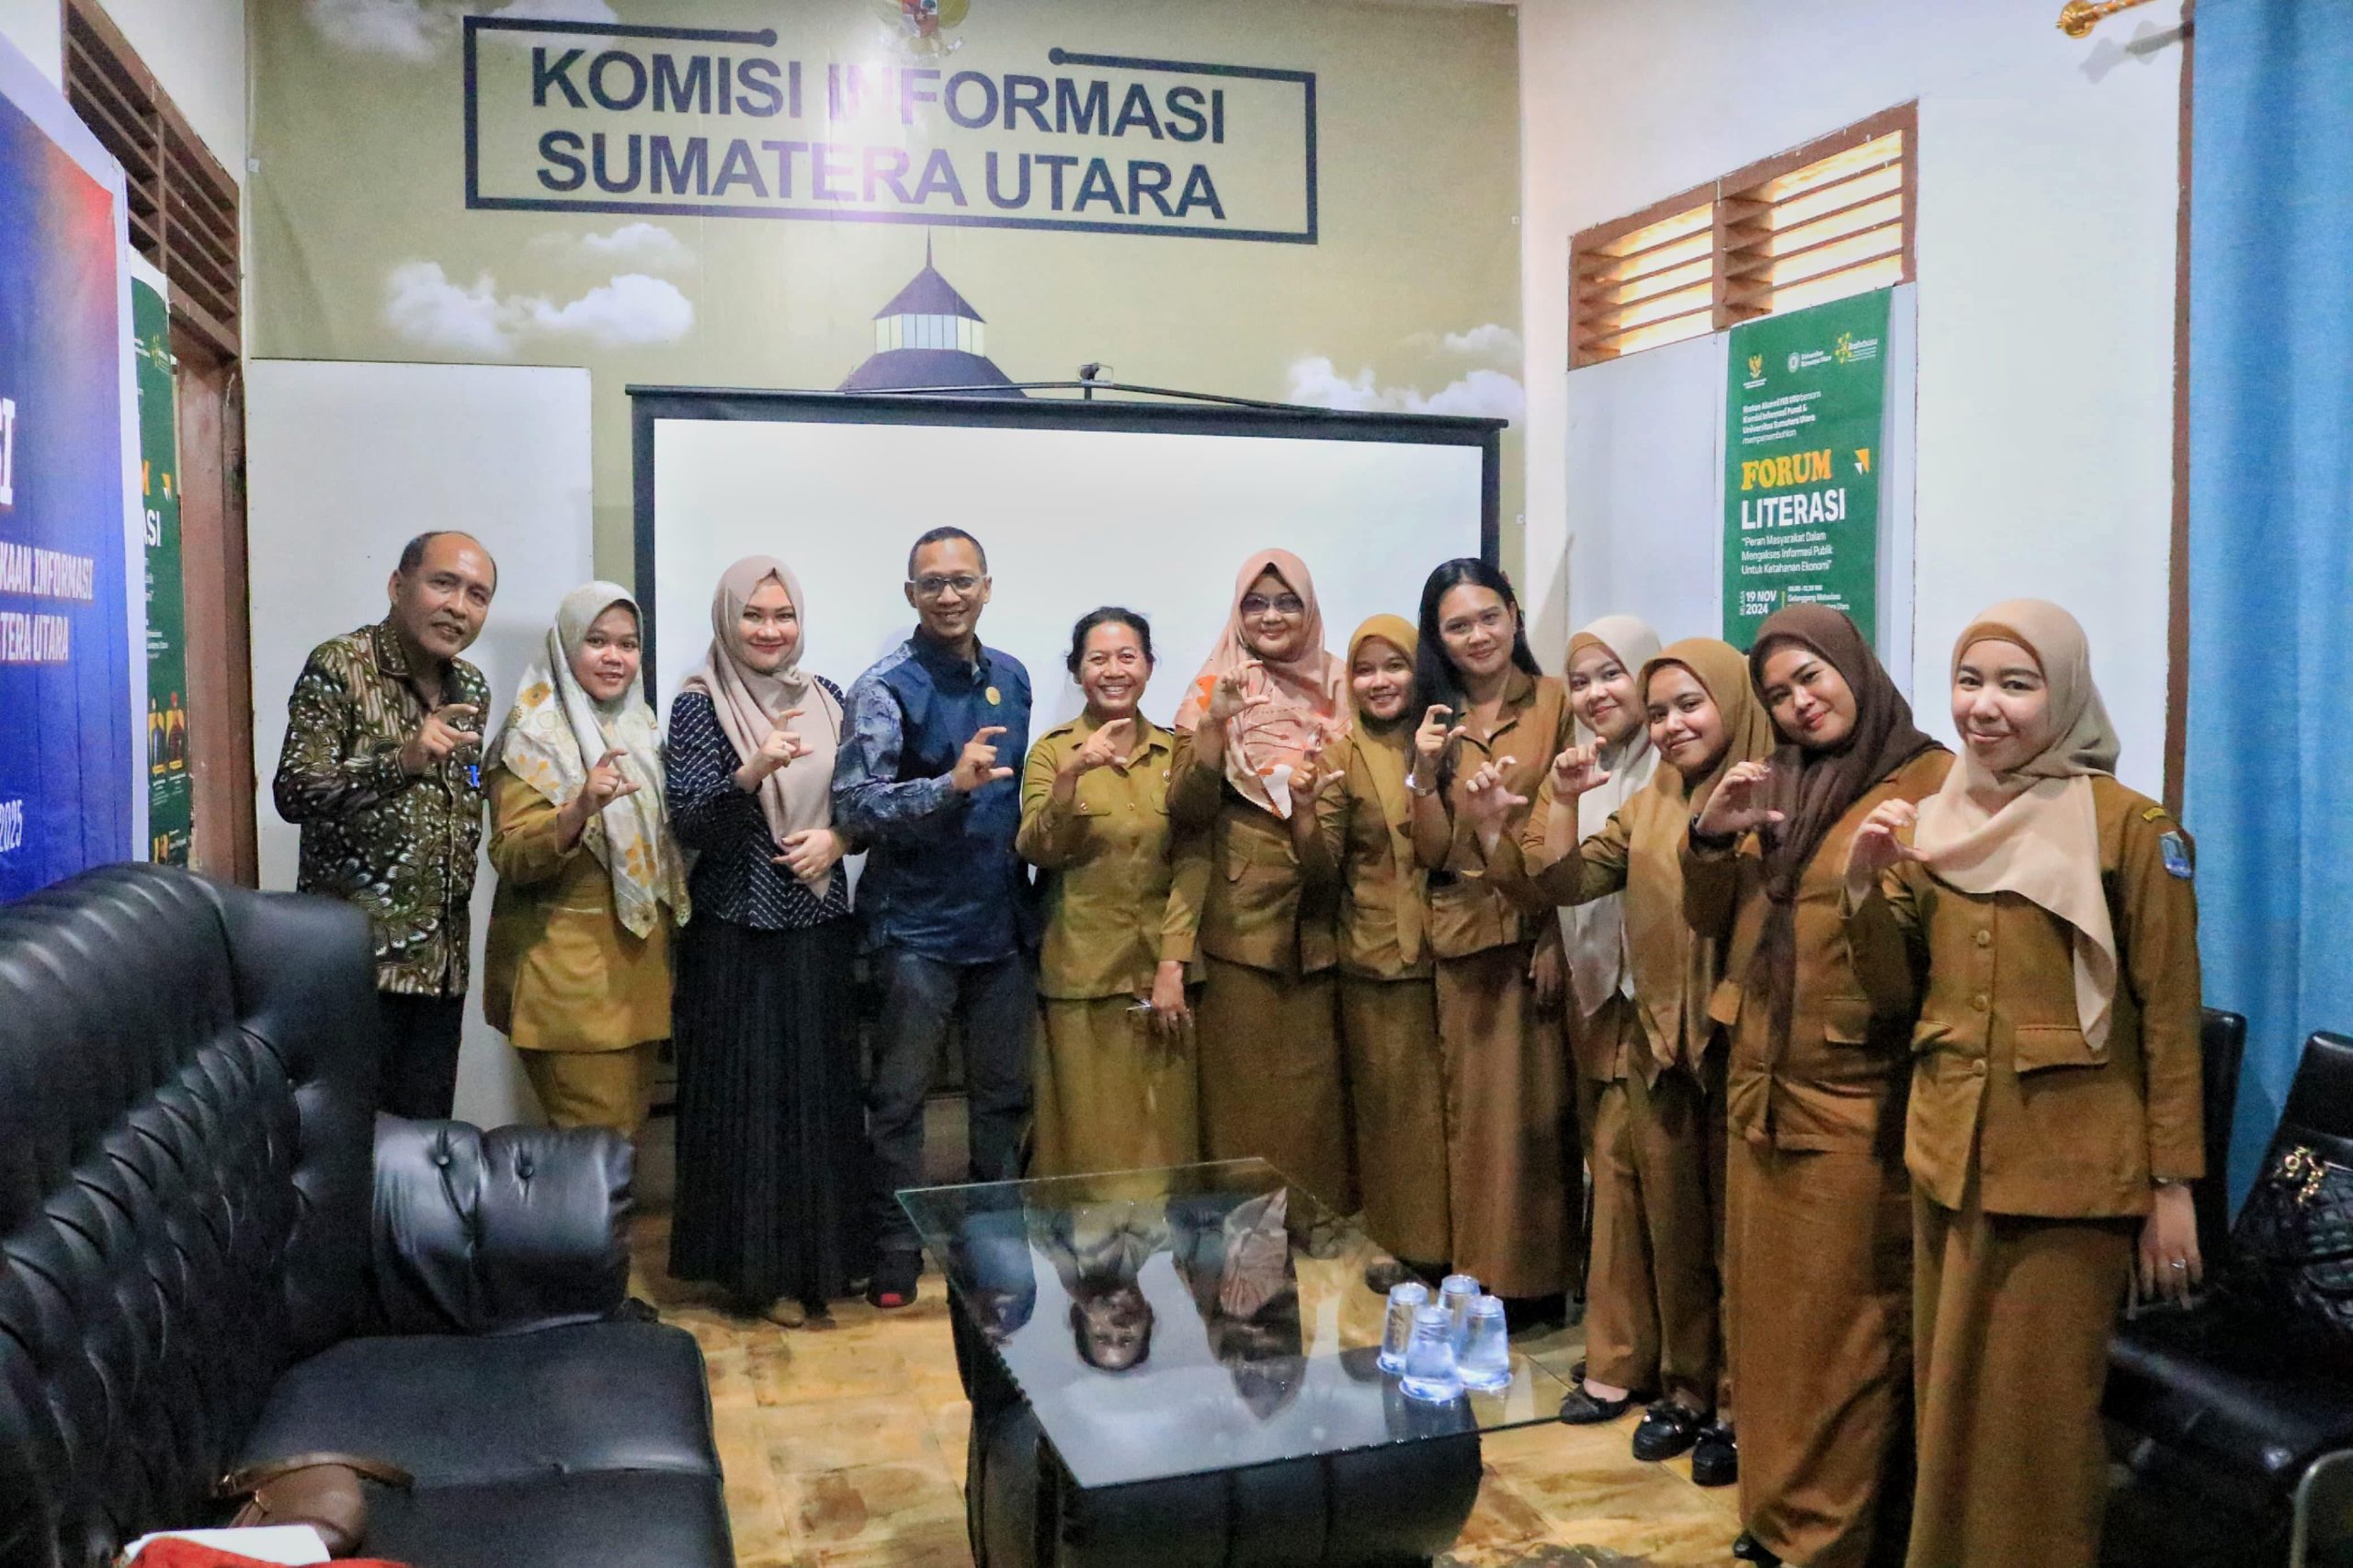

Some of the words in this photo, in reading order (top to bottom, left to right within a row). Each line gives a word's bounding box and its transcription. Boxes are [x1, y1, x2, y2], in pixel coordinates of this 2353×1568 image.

[531, 47, 802, 119] KOMISI
[829, 62, 1225, 144] INFORMASI
[536, 131, 969, 208] SUMATERA
[986, 150, 1226, 221] UTARA
[1741, 449, 1832, 490] FORUM
[1741, 488, 1846, 529] LITERASI
[1766, 533, 1805, 546] Masyarakat
[1806, 531, 1826, 542] Dalam
[33, 548, 94, 601] INFORMASI
[1742, 564, 1763, 574] Untuk
[1745, 591, 1756, 602] 19
[1757, 590, 1778, 602] NOV
[1745, 603, 1769, 615] 2024
[33, 613, 69, 662] UTARA
